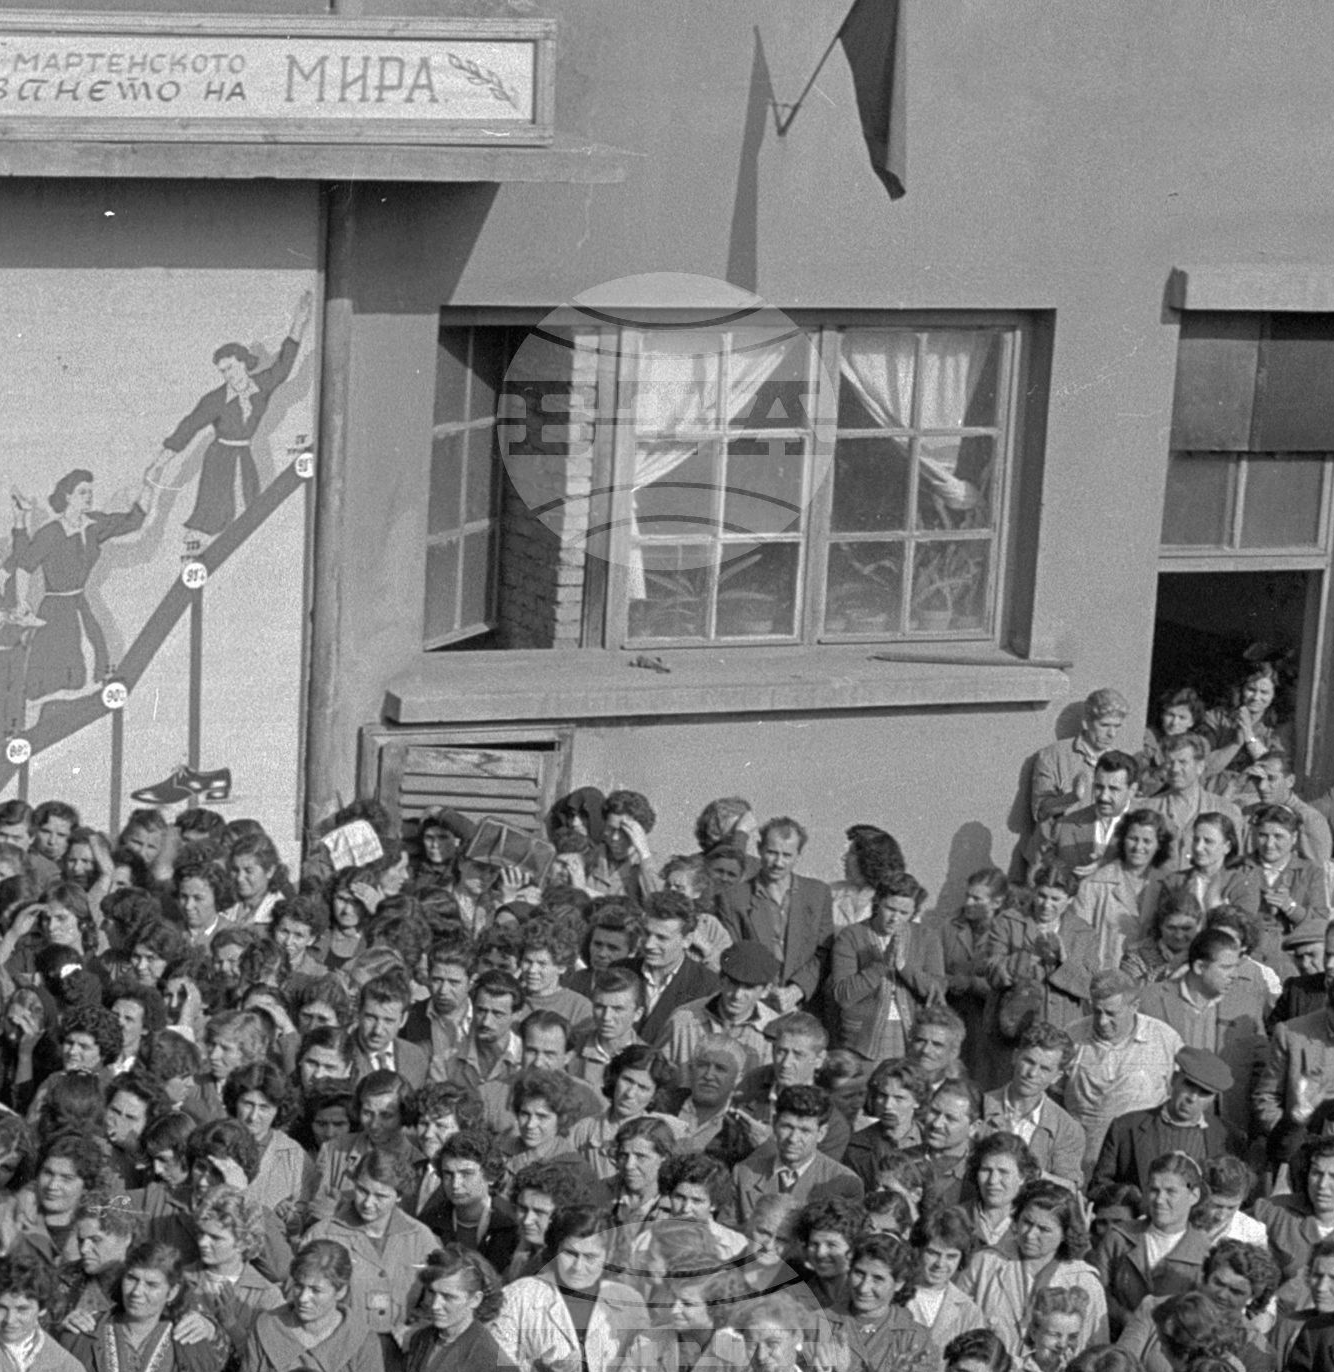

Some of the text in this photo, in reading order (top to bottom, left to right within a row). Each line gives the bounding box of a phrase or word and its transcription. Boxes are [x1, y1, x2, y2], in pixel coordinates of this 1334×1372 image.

[12, 52, 247, 75] МАРТЕНСКОТО
[283, 53, 440, 104] МИРА
[203, 80, 248, 103] НА
